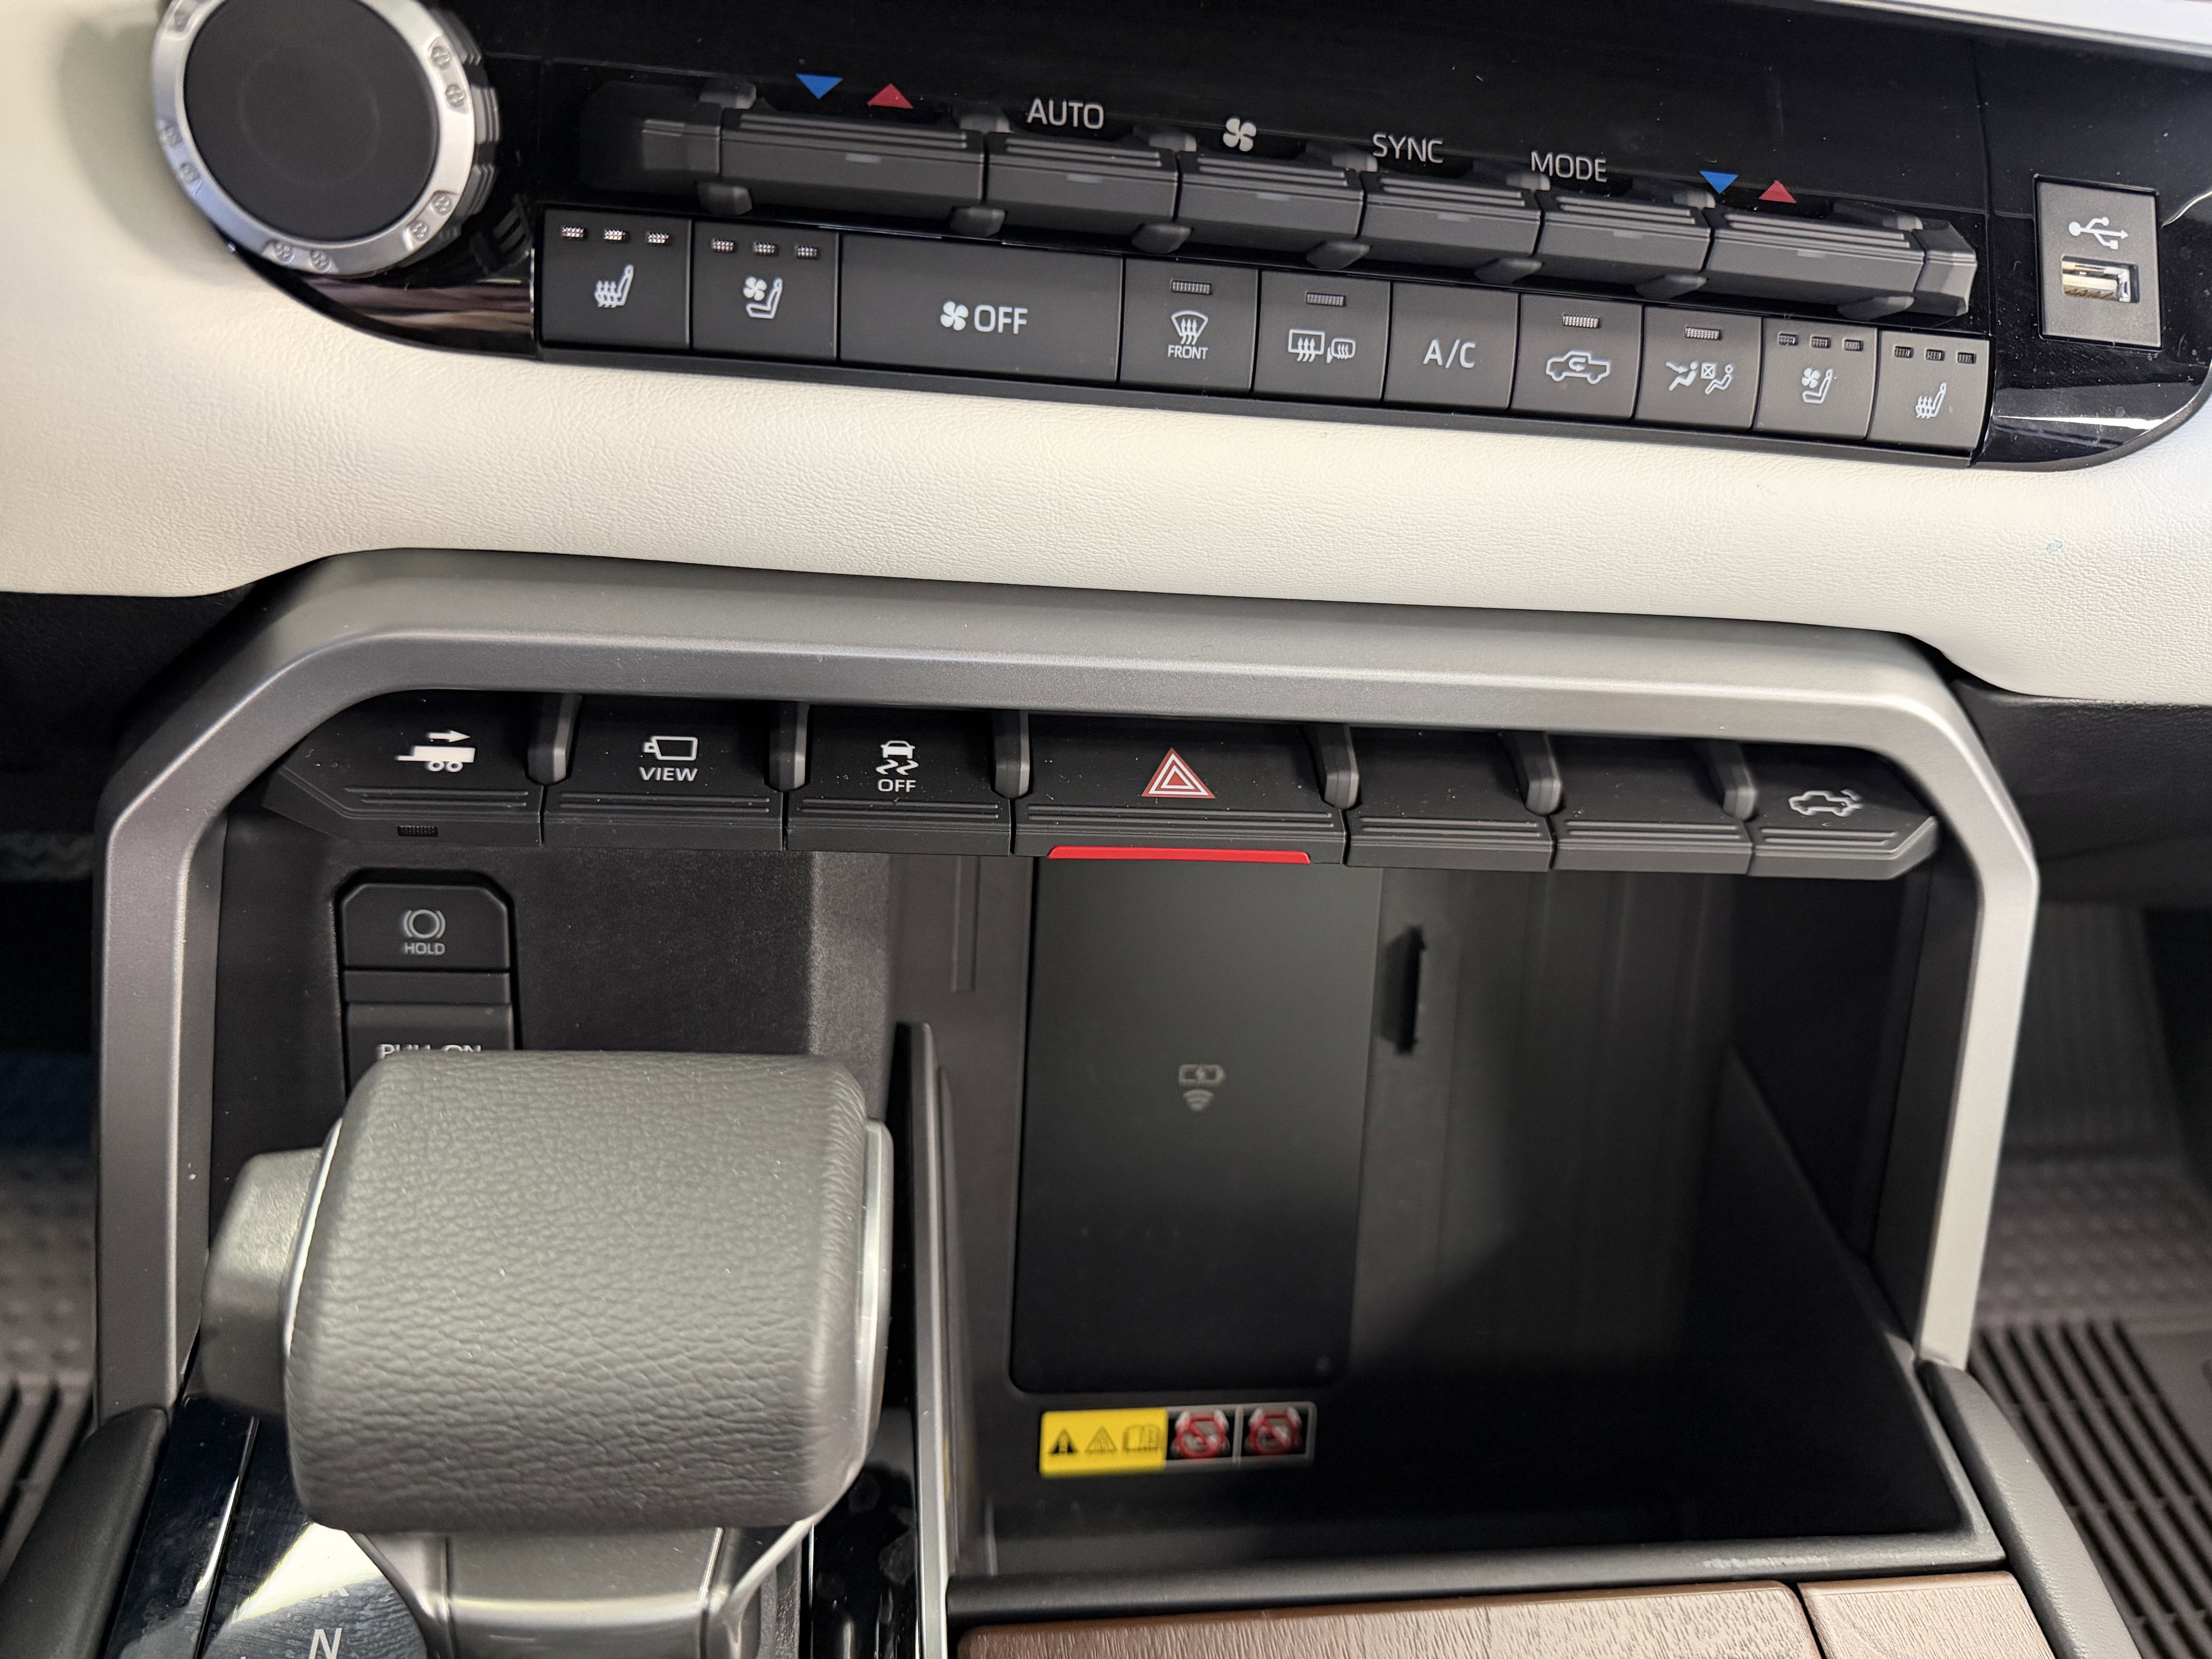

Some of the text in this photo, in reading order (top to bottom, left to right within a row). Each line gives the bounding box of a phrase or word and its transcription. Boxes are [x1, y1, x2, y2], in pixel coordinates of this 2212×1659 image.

[1027, 98, 1104, 129] AUTO
[1372, 132, 1443, 163] SYNC
[1531, 151, 1607, 182] MODE
[974, 304, 1028, 334] OFF
[1168, 345, 1208, 359] FRONT
[1423, 338, 1476, 369] A/C
[639, 767, 698, 781] VIEW
[878, 778, 916, 792] OFF
[404, 942, 445, 955] HOLD
[309, 1628, 343, 1659] N
